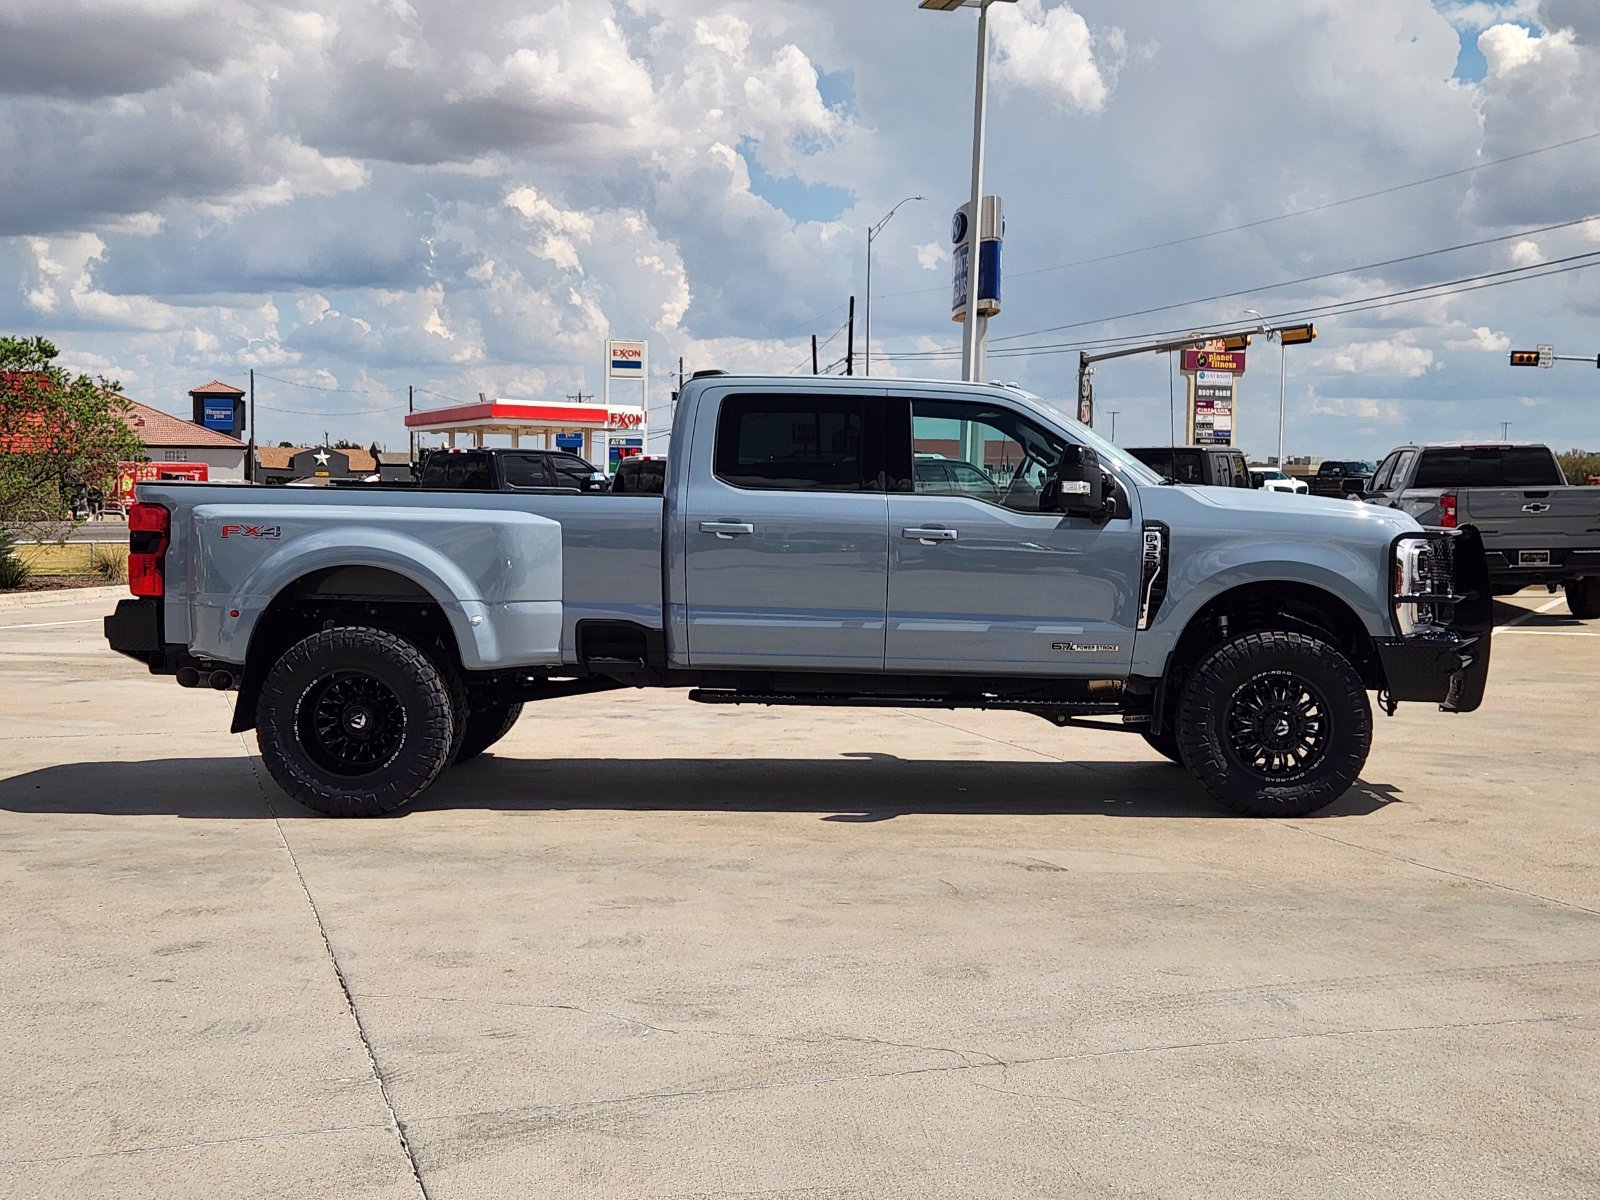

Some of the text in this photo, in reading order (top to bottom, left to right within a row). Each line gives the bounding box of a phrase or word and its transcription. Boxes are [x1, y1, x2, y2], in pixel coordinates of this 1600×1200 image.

[612, 348, 641, 359] EXXON
[1208, 353, 1233, 362] planet
[1211, 361, 1237, 369] fitness
[610, 411, 643, 429] EXXON
[221, 524, 281, 539] FX4
